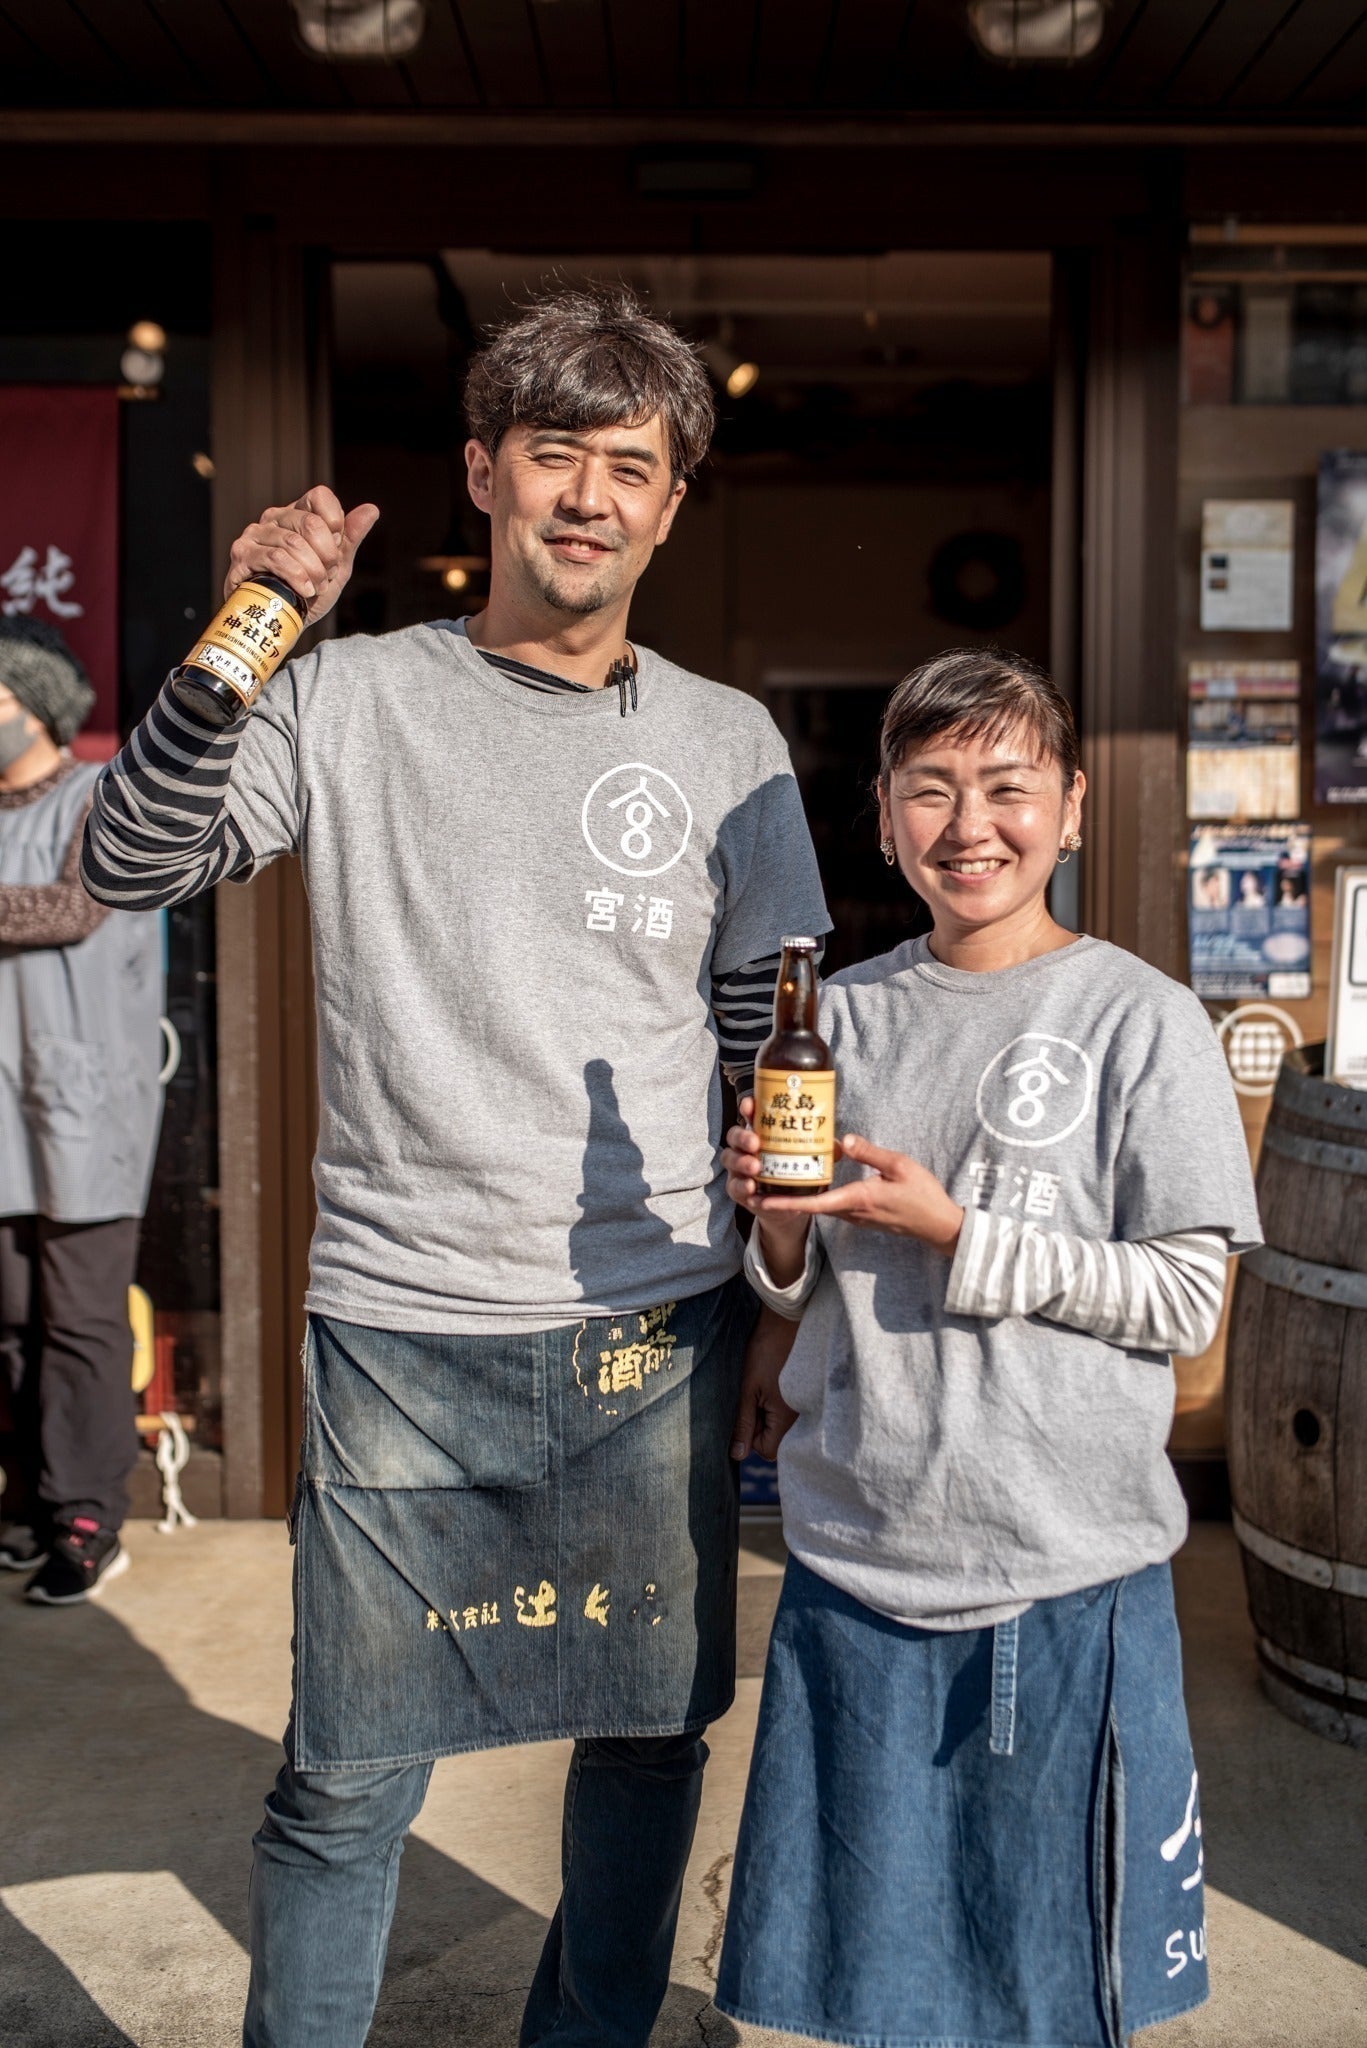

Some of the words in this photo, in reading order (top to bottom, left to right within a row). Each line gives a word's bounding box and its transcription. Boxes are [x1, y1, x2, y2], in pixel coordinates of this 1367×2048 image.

[222, 614, 280, 659] 神社ビア
[242, 603, 283, 638] 厳島
[584, 886, 674, 940] 宮酒
[771, 1092, 816, 1111] 厳島
[760, 1112, 827, 1132] 神社ビア
